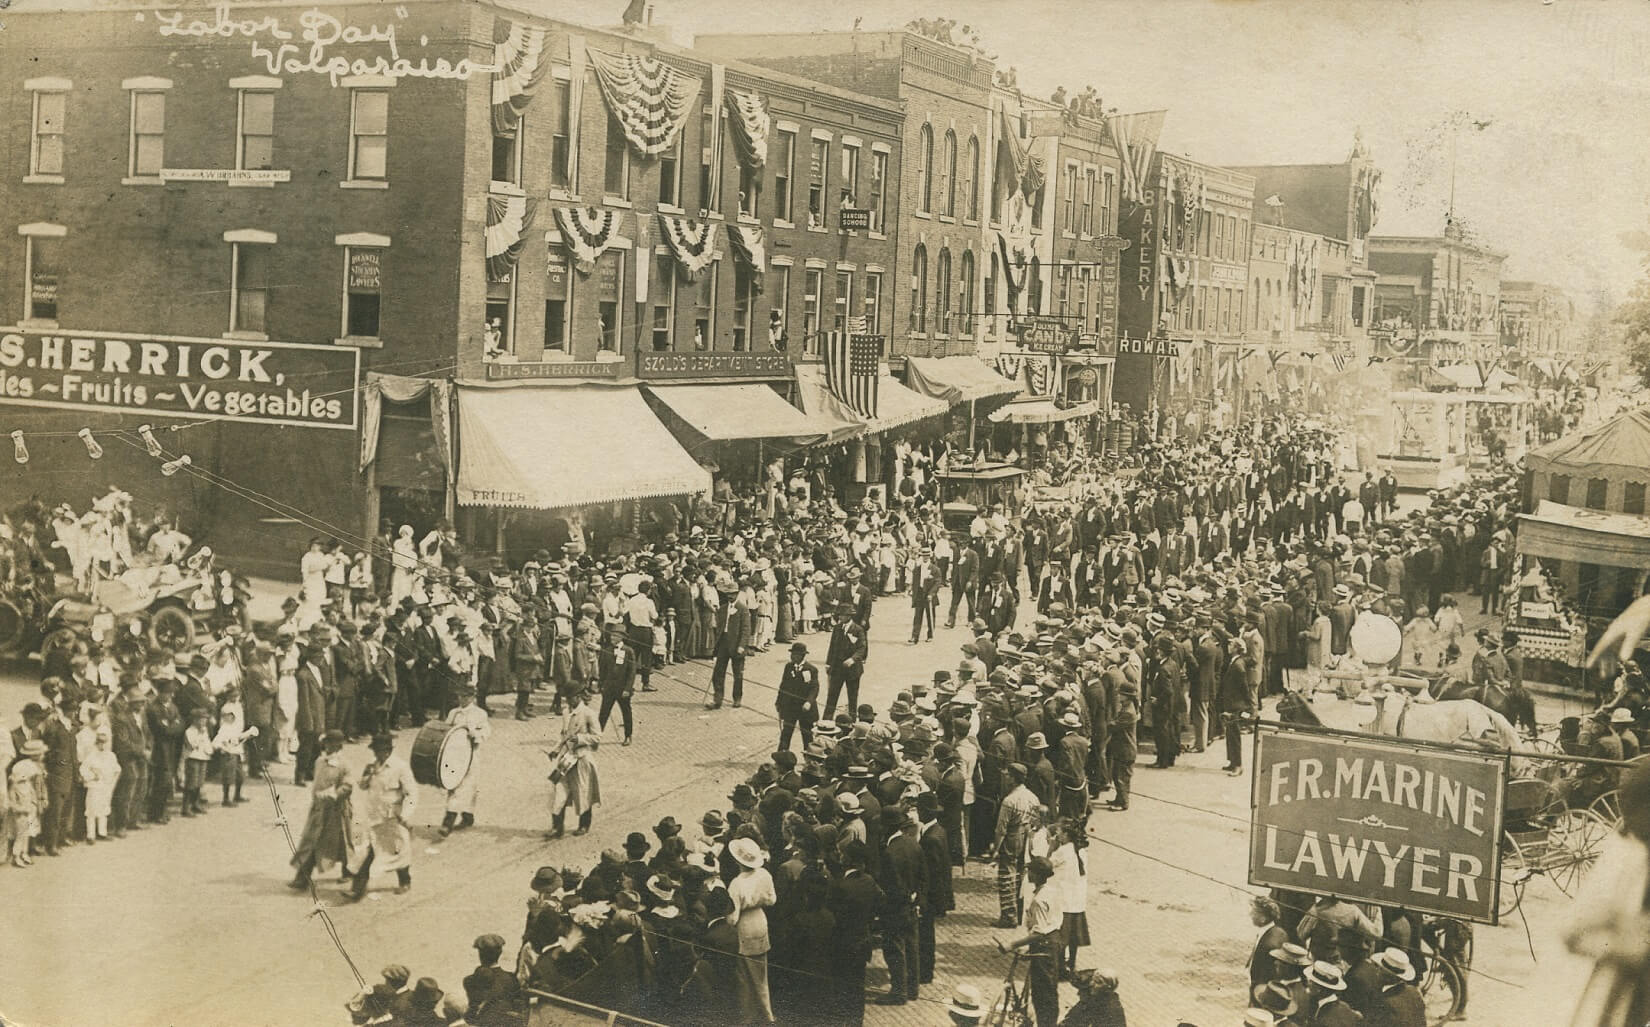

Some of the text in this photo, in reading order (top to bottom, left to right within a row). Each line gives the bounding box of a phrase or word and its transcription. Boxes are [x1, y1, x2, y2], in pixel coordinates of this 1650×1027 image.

[1138, 190, 1155, 301] BAKERY
[1100, 251, 1117, 354] JEWELRY
[1024, 323, 1075, 346] CANDY
[644, 354, 785, 372] SZOLD'S DEPARTMENT STORE
[62, 373, 148, 406] Fruits
[179, 382, 342, 420] Vegetables
[472, 489, 526, 502] FRUITS
[1263, 824, 1484, 902] LAWYER
